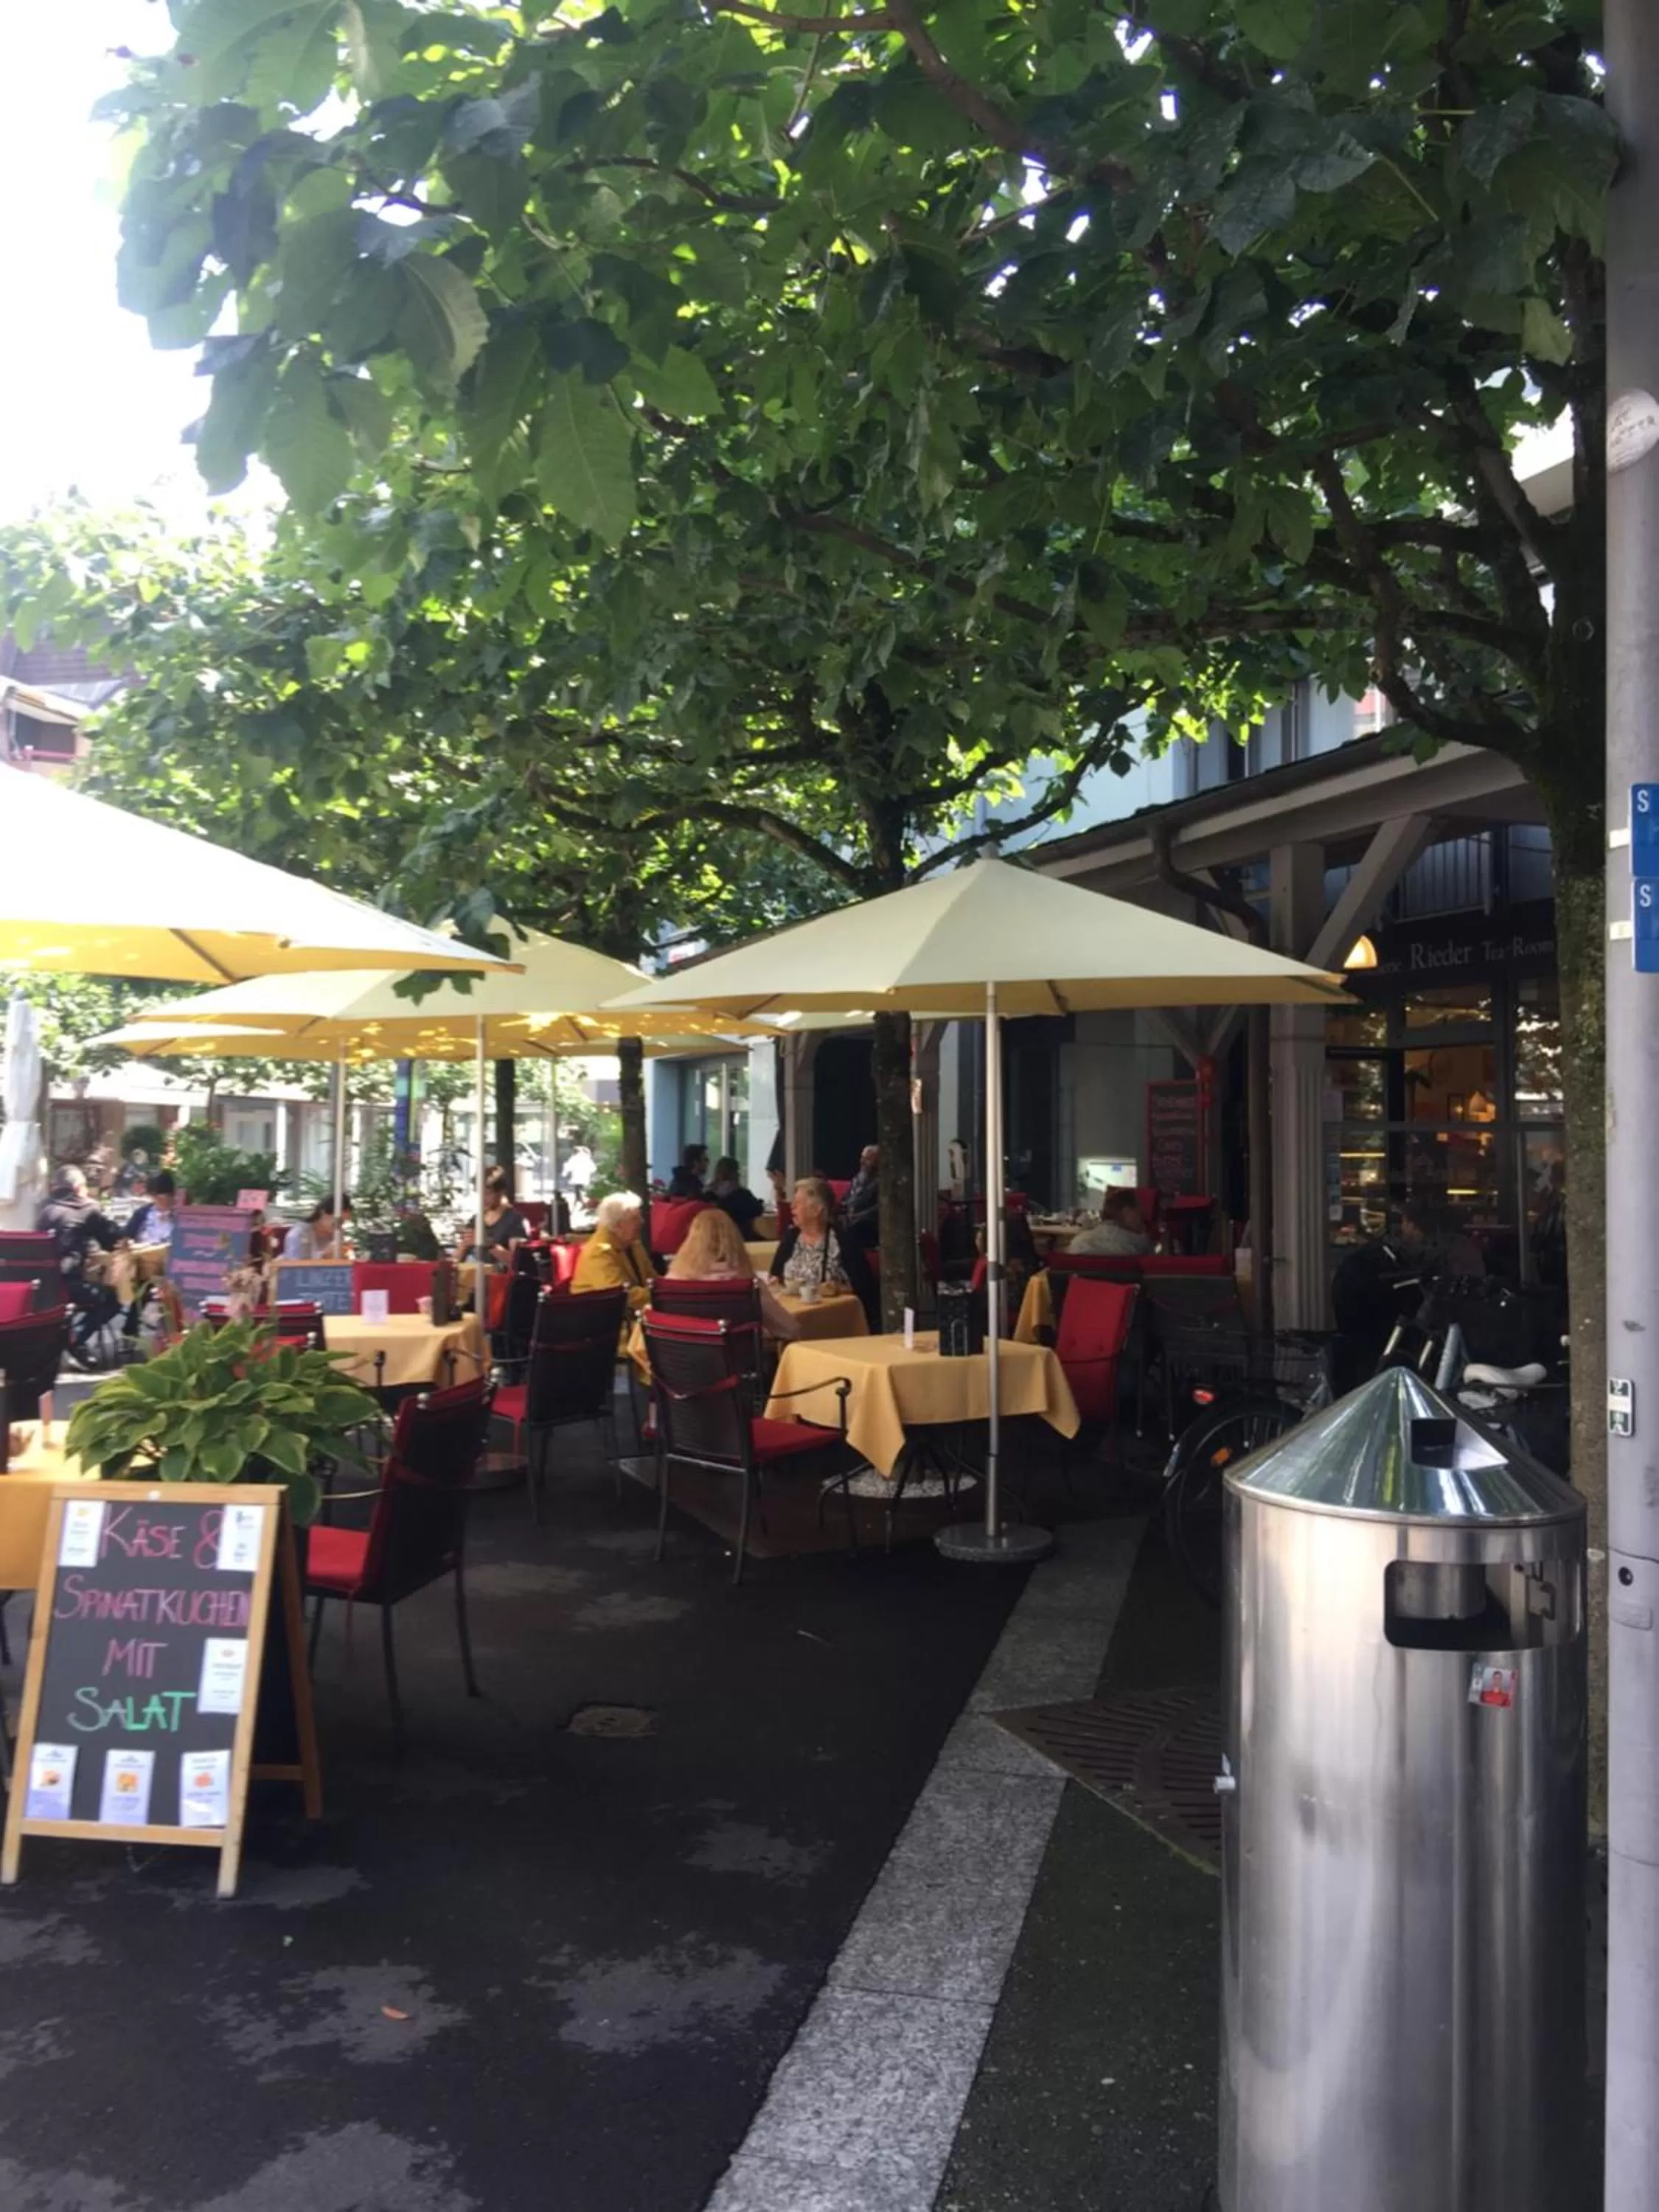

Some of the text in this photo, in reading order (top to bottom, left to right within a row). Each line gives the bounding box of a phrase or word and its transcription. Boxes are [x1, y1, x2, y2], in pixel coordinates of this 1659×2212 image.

[1637, 790, 1649, 813] S
[1639, 884, 1652, 908] S
[1409, 937, 1473, 970] Rieder
[101, 1637, 169, 1678] MIT
[66, 1686, 198, 1733] SALAT
